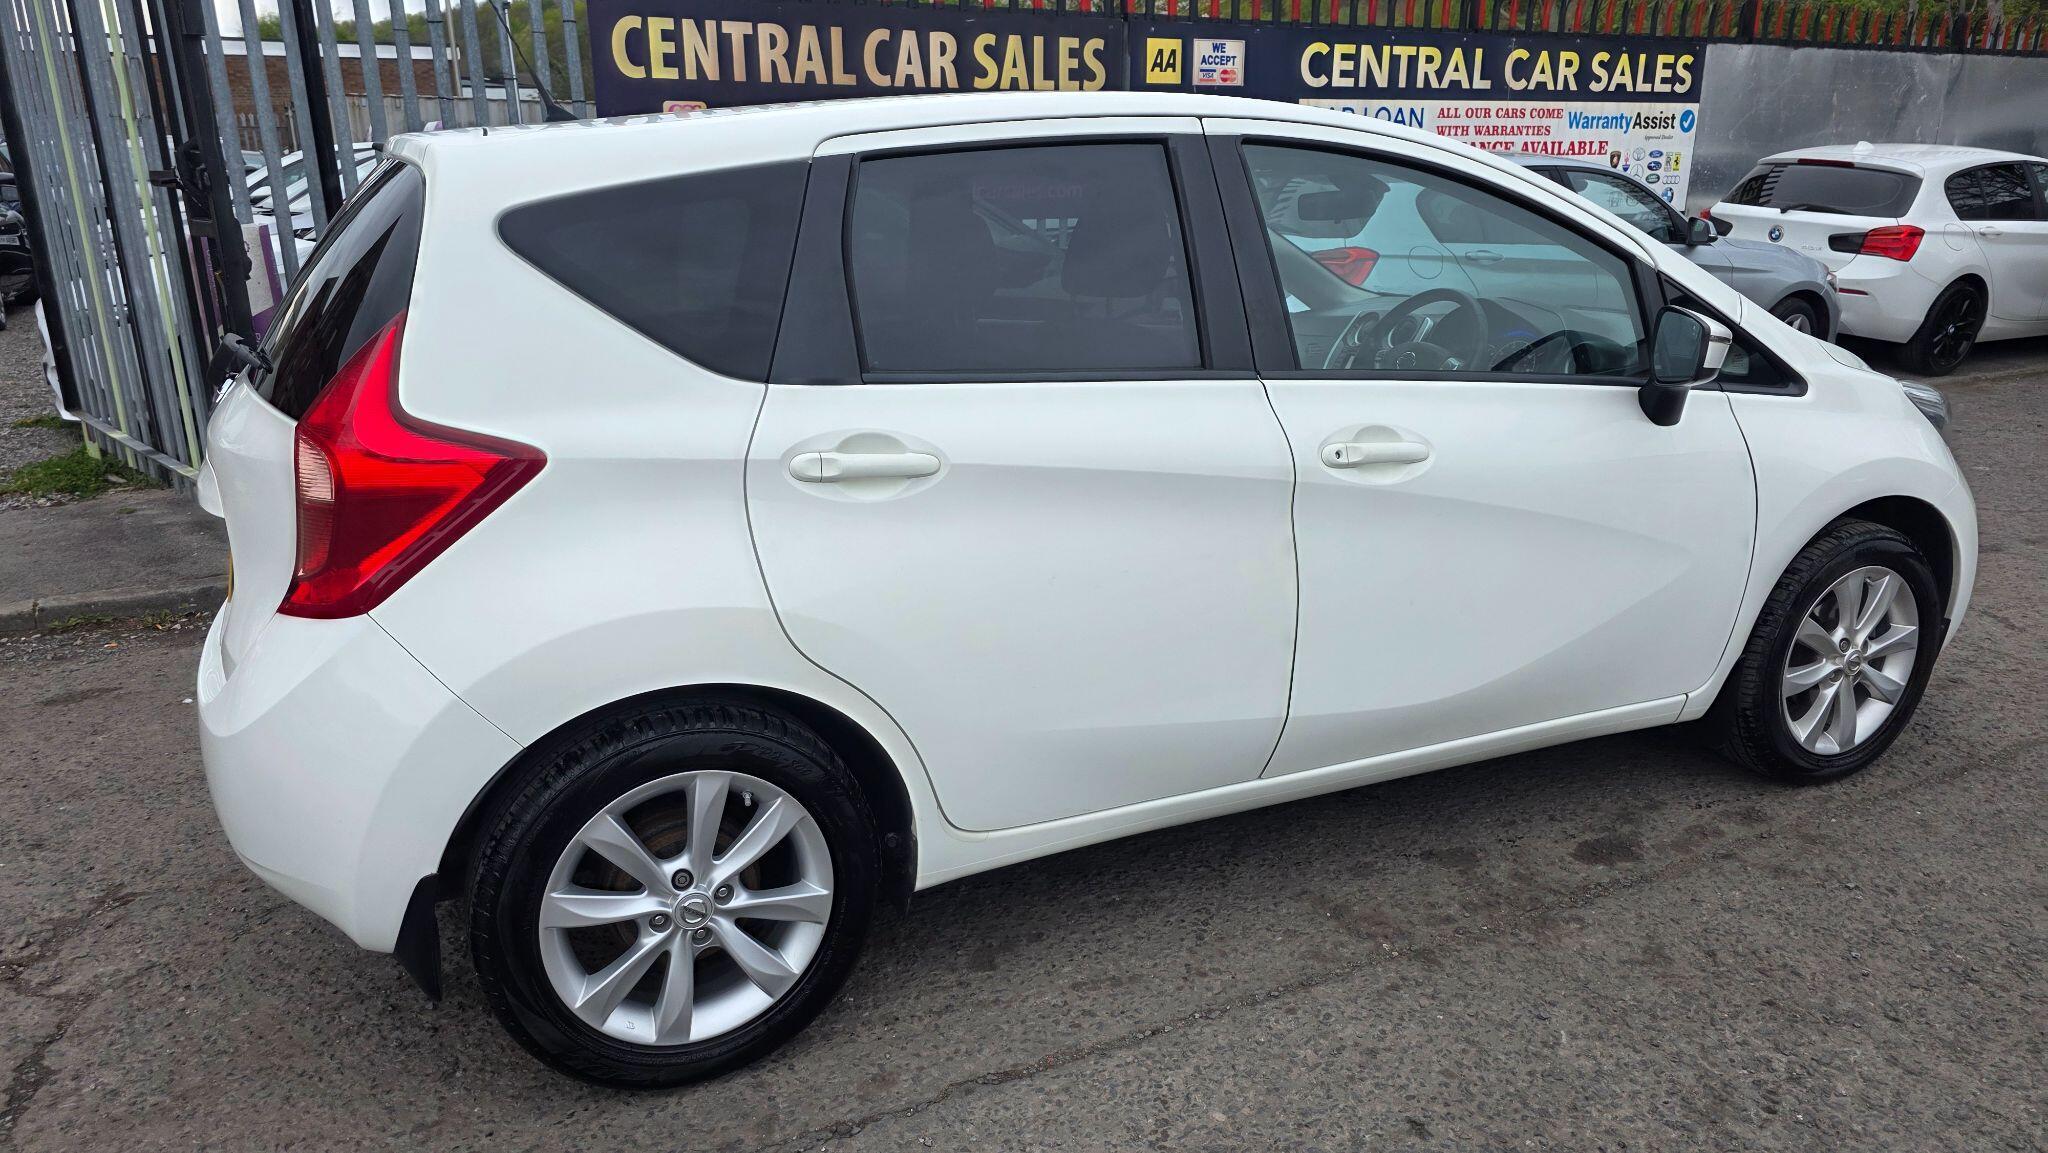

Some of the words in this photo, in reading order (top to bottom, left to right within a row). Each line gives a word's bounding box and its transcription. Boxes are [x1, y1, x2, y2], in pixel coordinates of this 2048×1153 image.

[611, 15, 857, 85] CENTRAL
[863, 29, 960, 89] CAR
[973, 33, 1107, 91] SALES
[1212, 42, 1226, 53] WE
[1150, 48, 1177, 72] AA
[1200, 55, 1237, 66] ACCEPT
[1301, 42, 1491, 90] CENTRAL
[1504, 48, 1581, 91] CAR
[1589, 51, 1695, 94] SALES
[1437, 107, 1461, 118] ALL
[1465, 107, 1492, 118] OUR
[1495, 108, 1526, 119] CARS
[1530, 108, 1564, 119] COME
[1436, 125, 1469, 136] WITH
[1474, 125, 1551, 136] WARRANTIES
[1521, 141, 1608, 156] AVAILABLE
